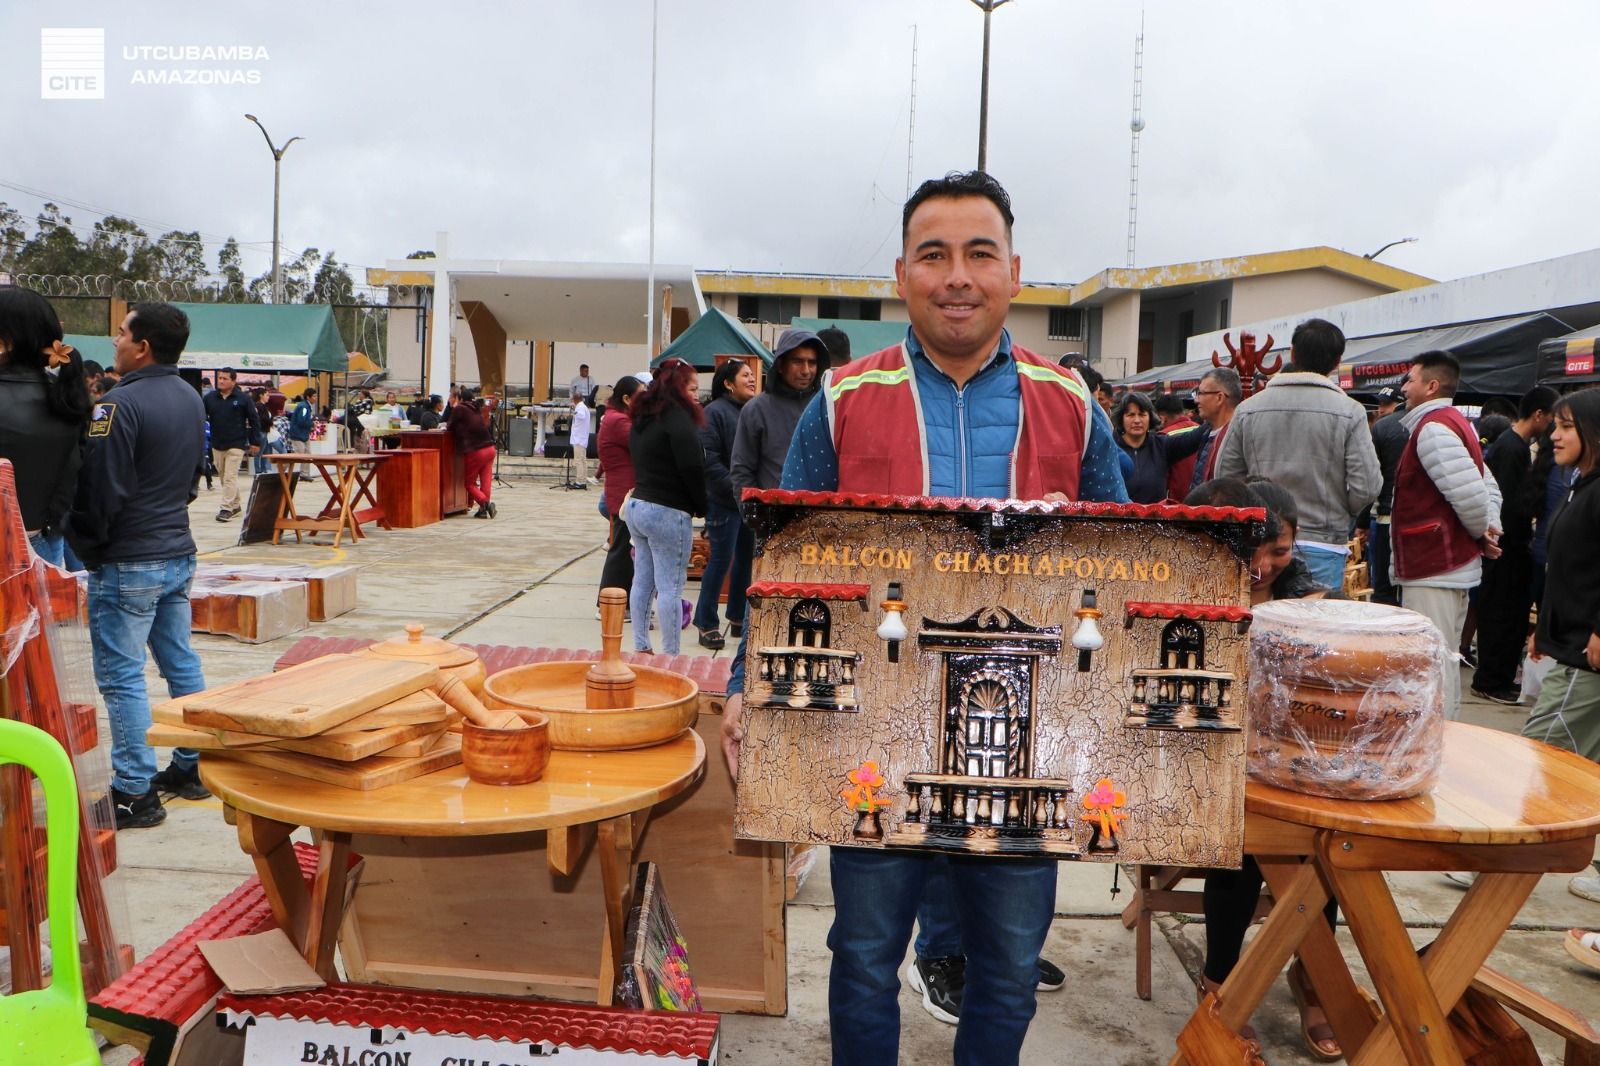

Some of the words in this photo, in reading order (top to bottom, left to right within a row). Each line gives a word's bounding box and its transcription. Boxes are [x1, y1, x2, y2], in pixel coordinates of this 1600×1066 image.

[1567, 361, 1590, 371] CITE
[800, 544, 912, 570] BALCON
[934, 552, 1171, 582] CHACHAPOYANO
[301, 1042, 411, 1066] BALCON
